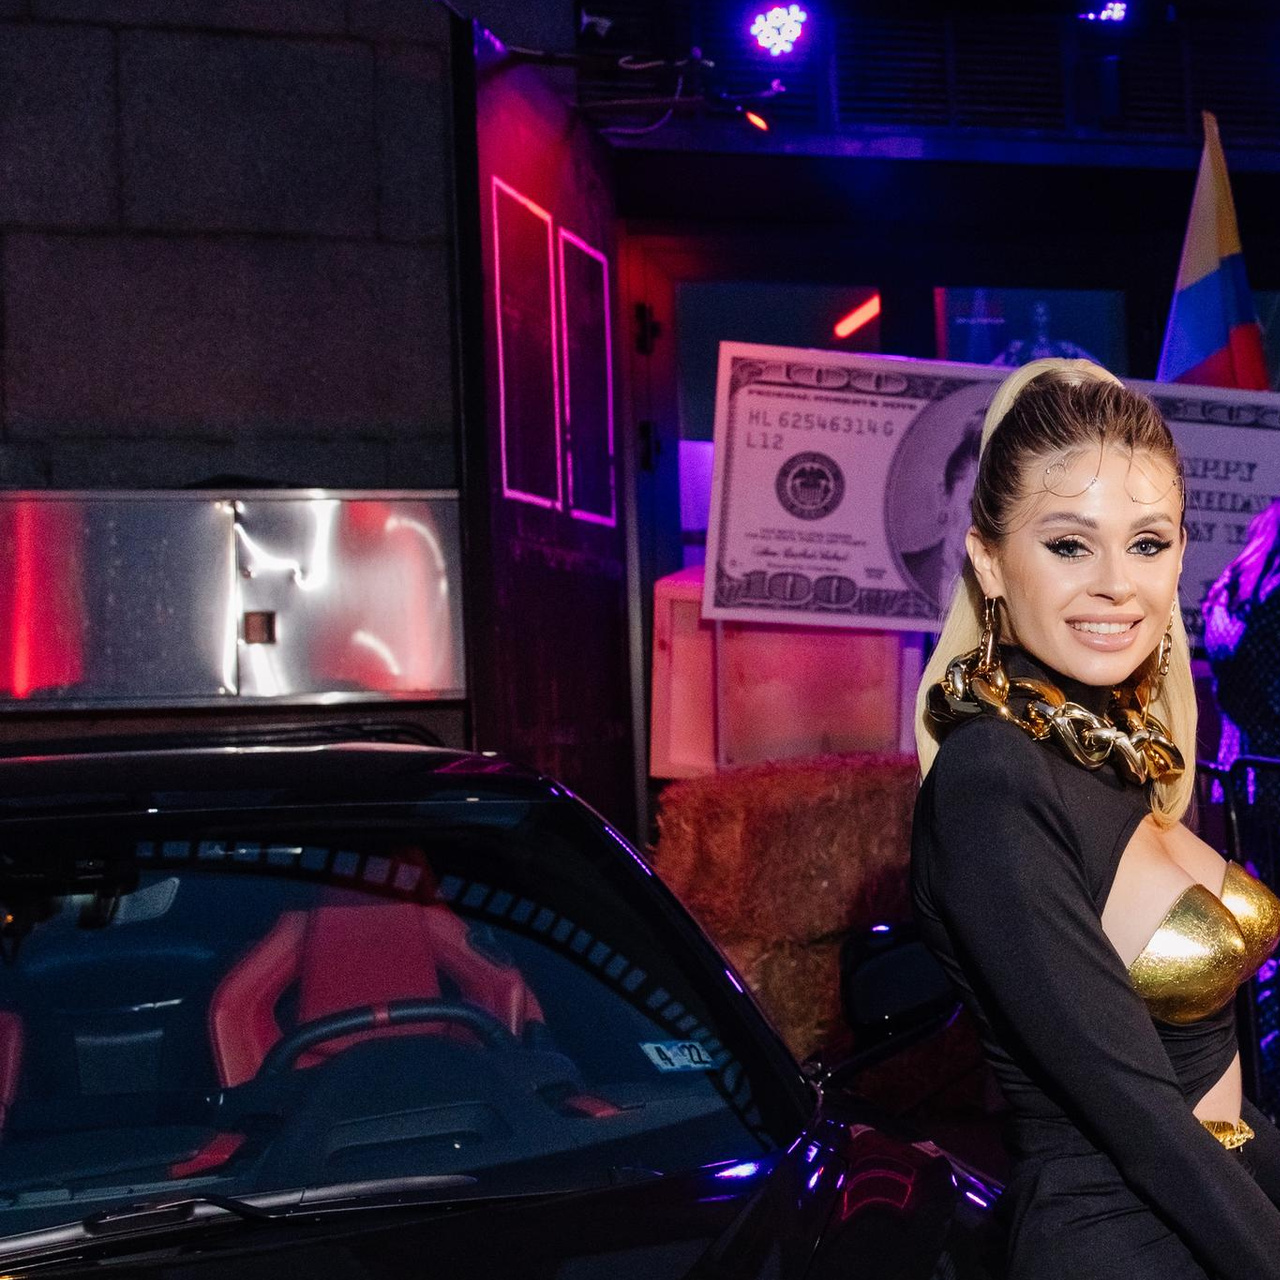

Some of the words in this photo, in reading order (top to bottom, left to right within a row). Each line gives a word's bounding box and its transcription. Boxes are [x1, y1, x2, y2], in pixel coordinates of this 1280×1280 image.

[748, 408, 772, 427] HL
[778, 410, 877, 434] 62546314
[746, 432, 784, 450] L12
[740, 570, 859, 608] 100
